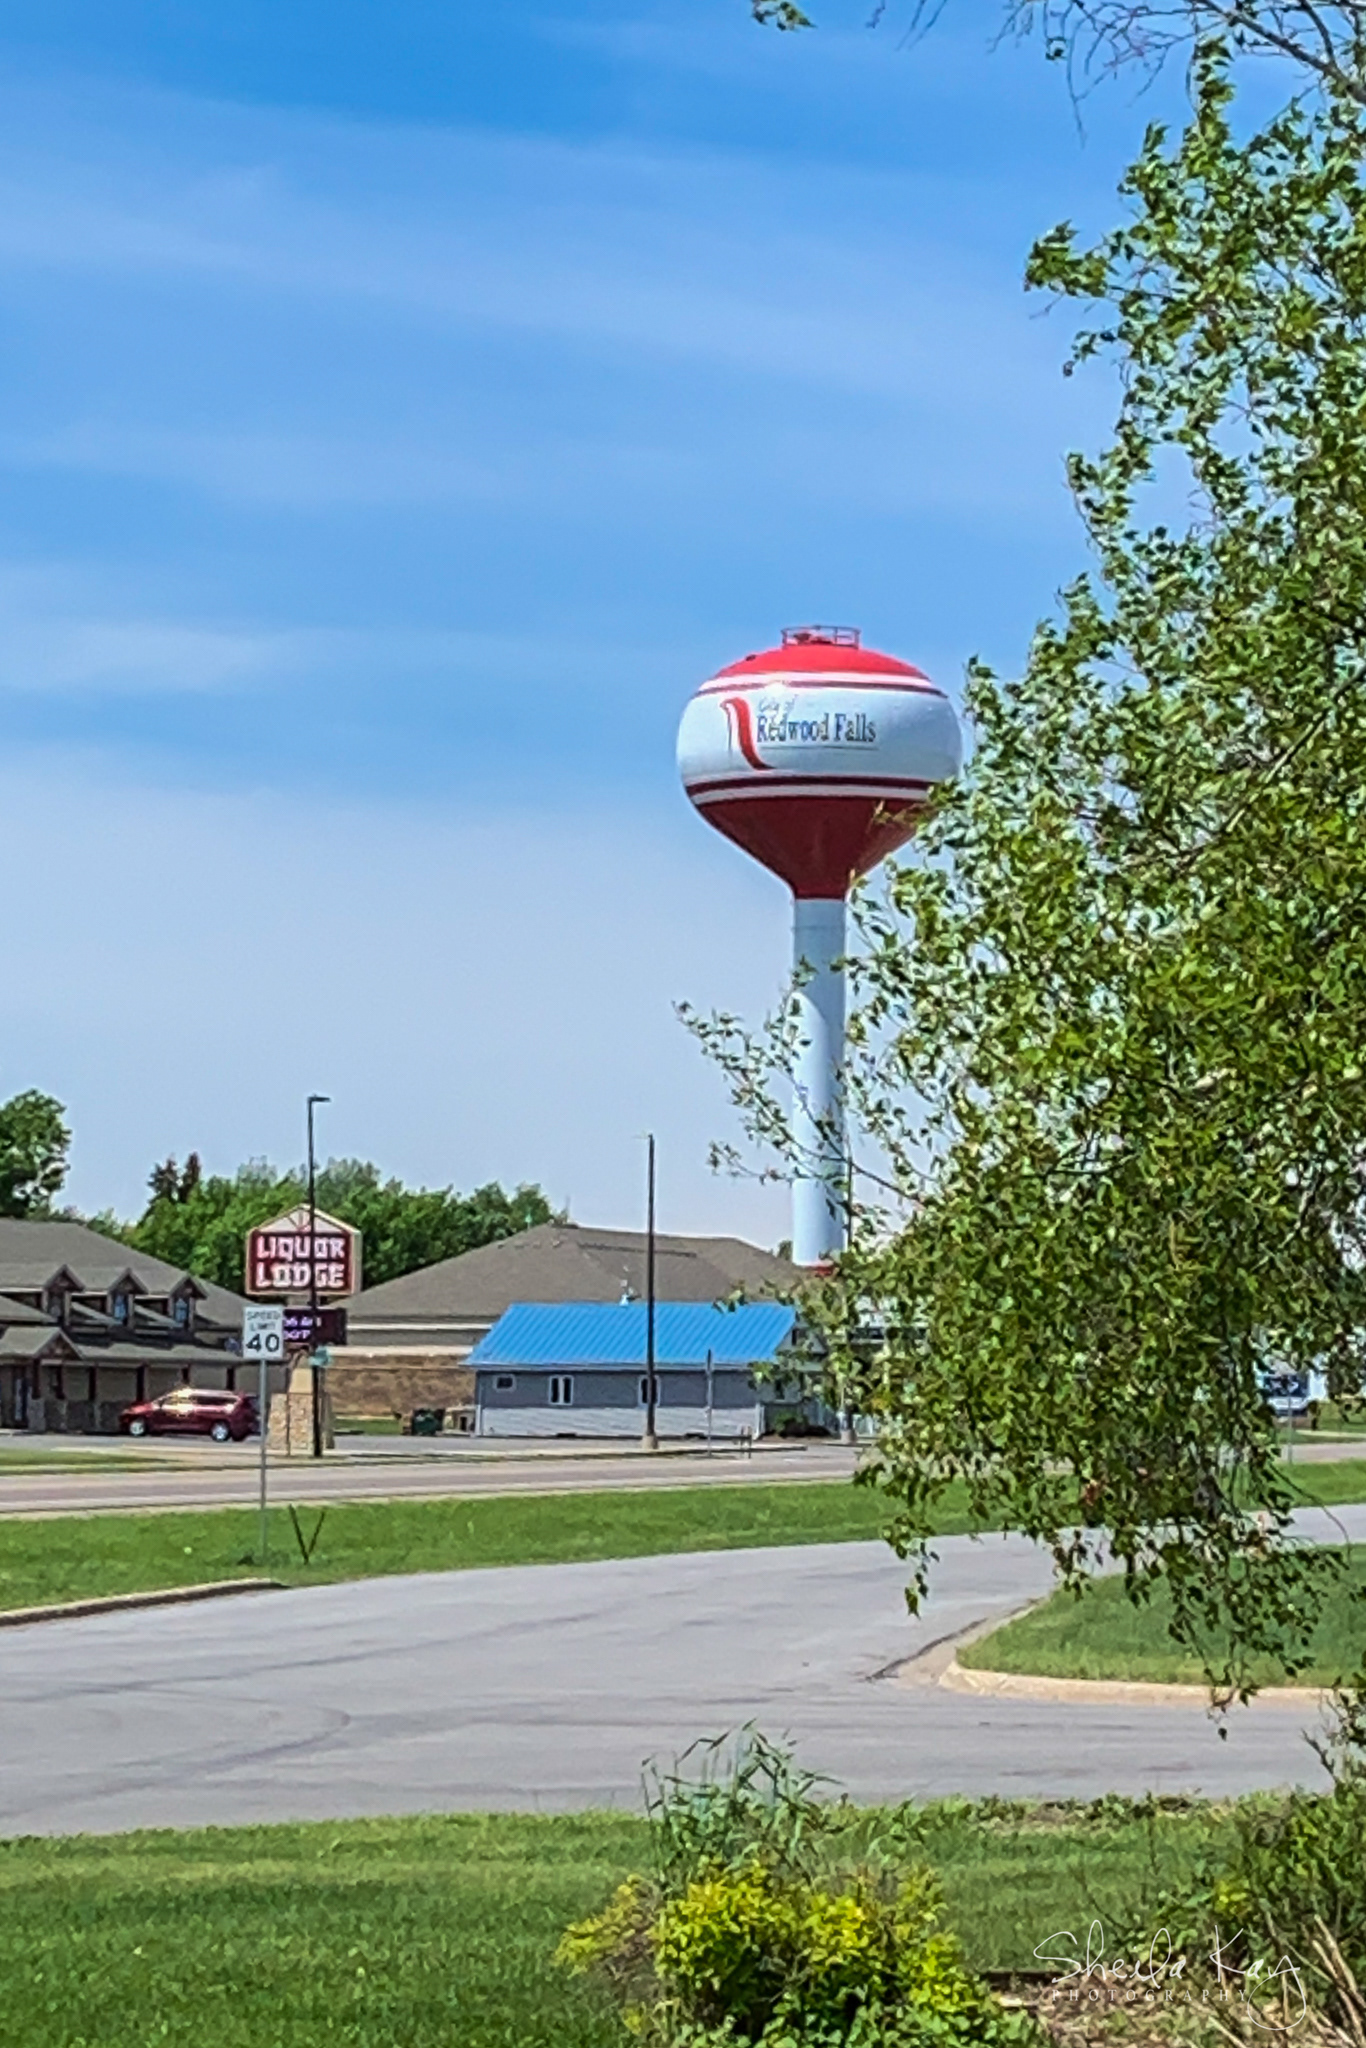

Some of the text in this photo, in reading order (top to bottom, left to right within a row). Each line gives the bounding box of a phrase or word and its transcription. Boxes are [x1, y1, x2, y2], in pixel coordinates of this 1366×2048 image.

[759, 694, 798, 713] City of
[756, 713, 877, 742] Redwood Falls
[256, 1235, 345, 1261] LIQUOR
[255, 1262, 345, 1288] LODGE
[247, 1311, 280, 1320] SPEED
[250, 1322, 276, 1331] LIMIT
[245, 1333, 280, 1352] 40
